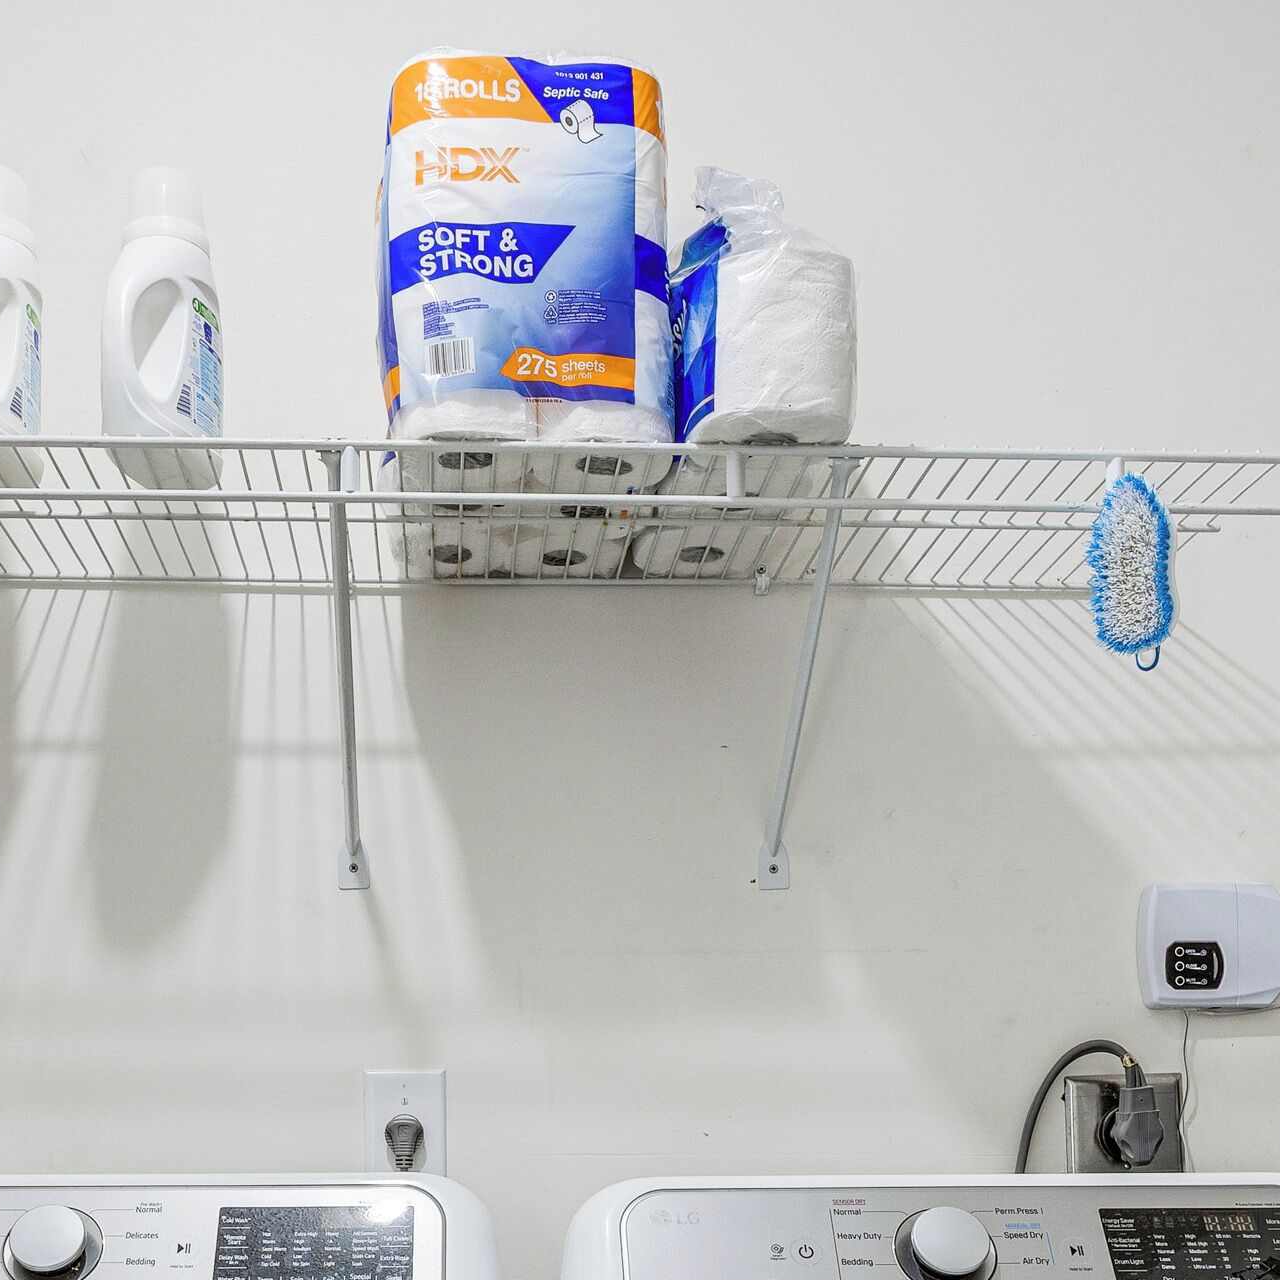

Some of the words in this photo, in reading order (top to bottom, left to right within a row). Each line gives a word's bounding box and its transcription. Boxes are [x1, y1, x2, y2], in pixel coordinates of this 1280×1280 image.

[443, 77, 521, 103] ROLLS
[543, 86, 580, 99] Septic
[583, 88, 608, 100] Safe
[415, 147, 520, 186] HDX
[418, 226, 490, 251] SOFT
[499, 228, 519, 251] &
[420, 249, 534, 277] STRONG
[517, 353, 557, 378] 275
[562, 360, 605, 373] sheets
[562, 374, 576, 382] per
[579, 371, 592, 379] roll
[837, 1232, 861, 1241] Heavy
[863, 1232, 881, 1240] Duty
[1004, 1232, 1026, 1240] Speed
[1028, 1231, 1044, 1240] Dry
[125, 1258, 156, 1267] Bedding
[842, 1258, 873, 1266] Bedding
[1036, 1258, 1049, 1266] Dry
